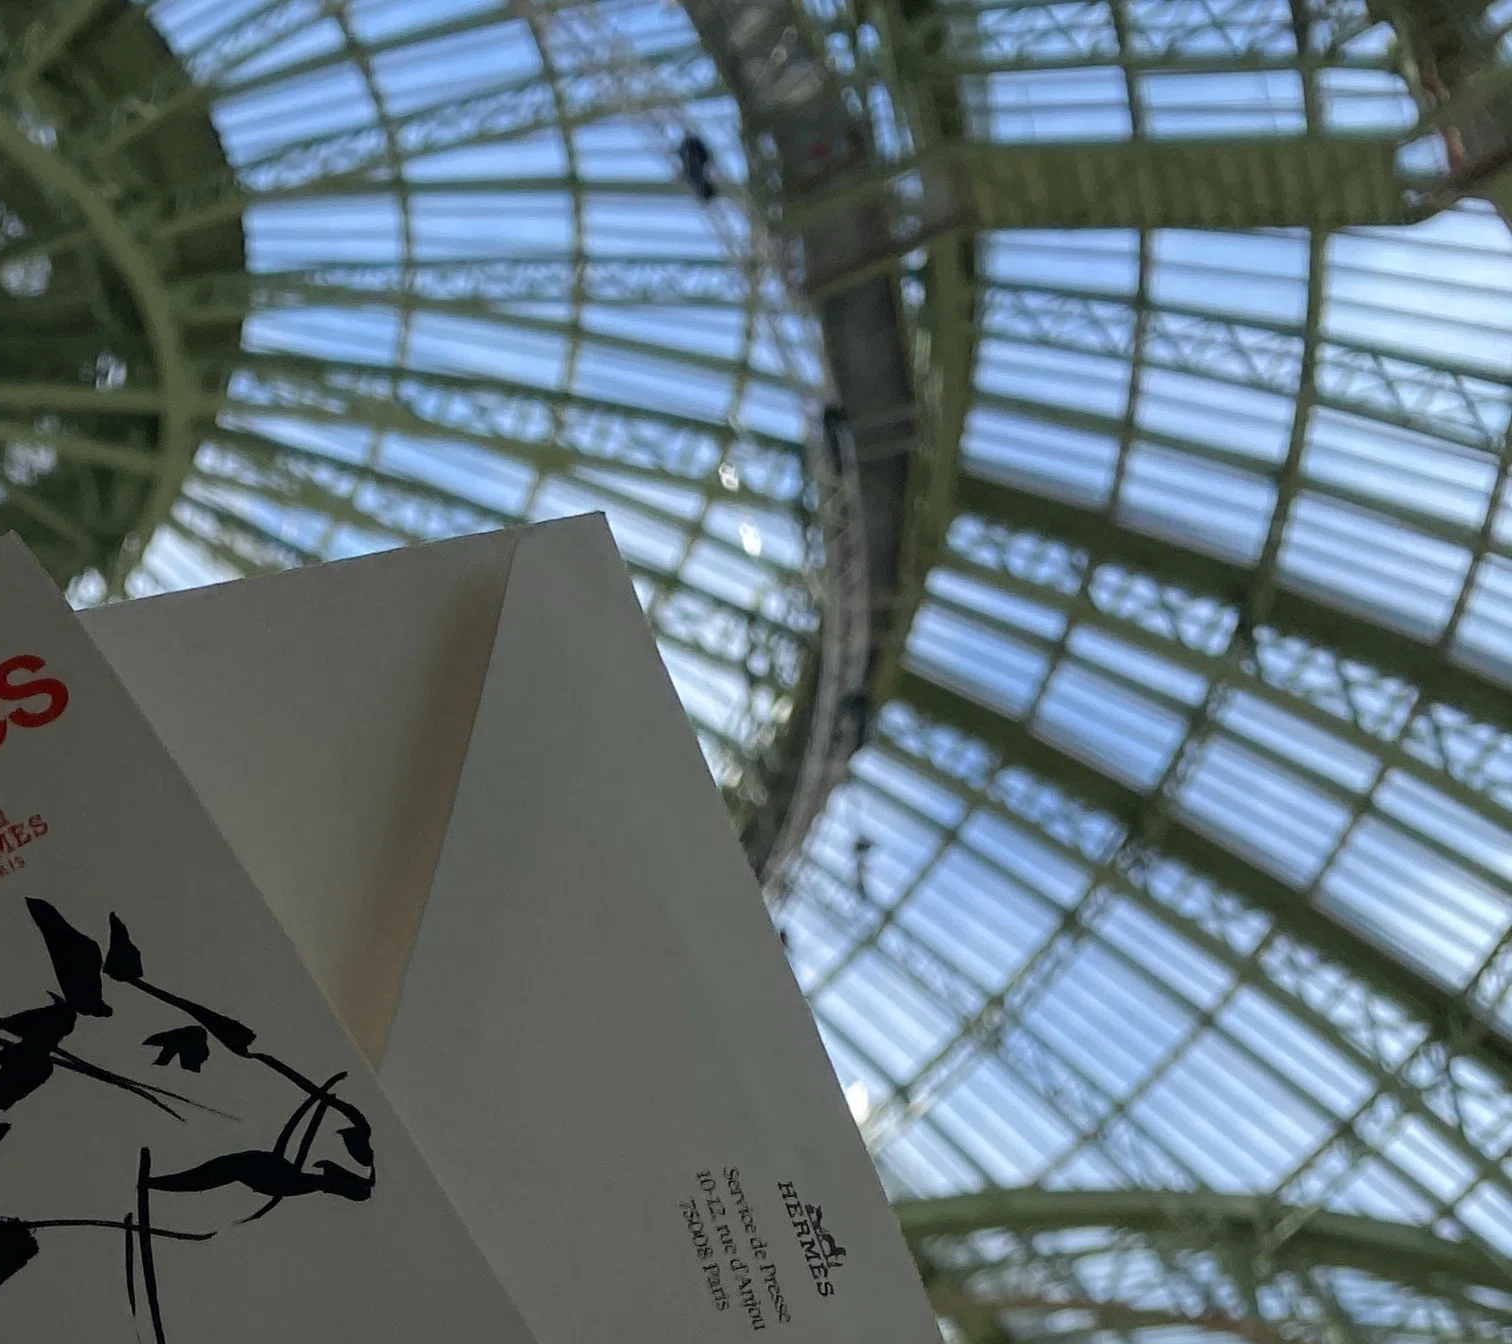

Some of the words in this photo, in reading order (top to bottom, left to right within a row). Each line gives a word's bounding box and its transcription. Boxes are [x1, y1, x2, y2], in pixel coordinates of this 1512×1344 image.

[715, 1224, 738, 1255] rue
[723, 1165, 758, 1235] Service
[749, 1236, 769, 1261] de
[759, 1263, 791, 1324] Presse
[702, 1262, 730, 1312] Paris
